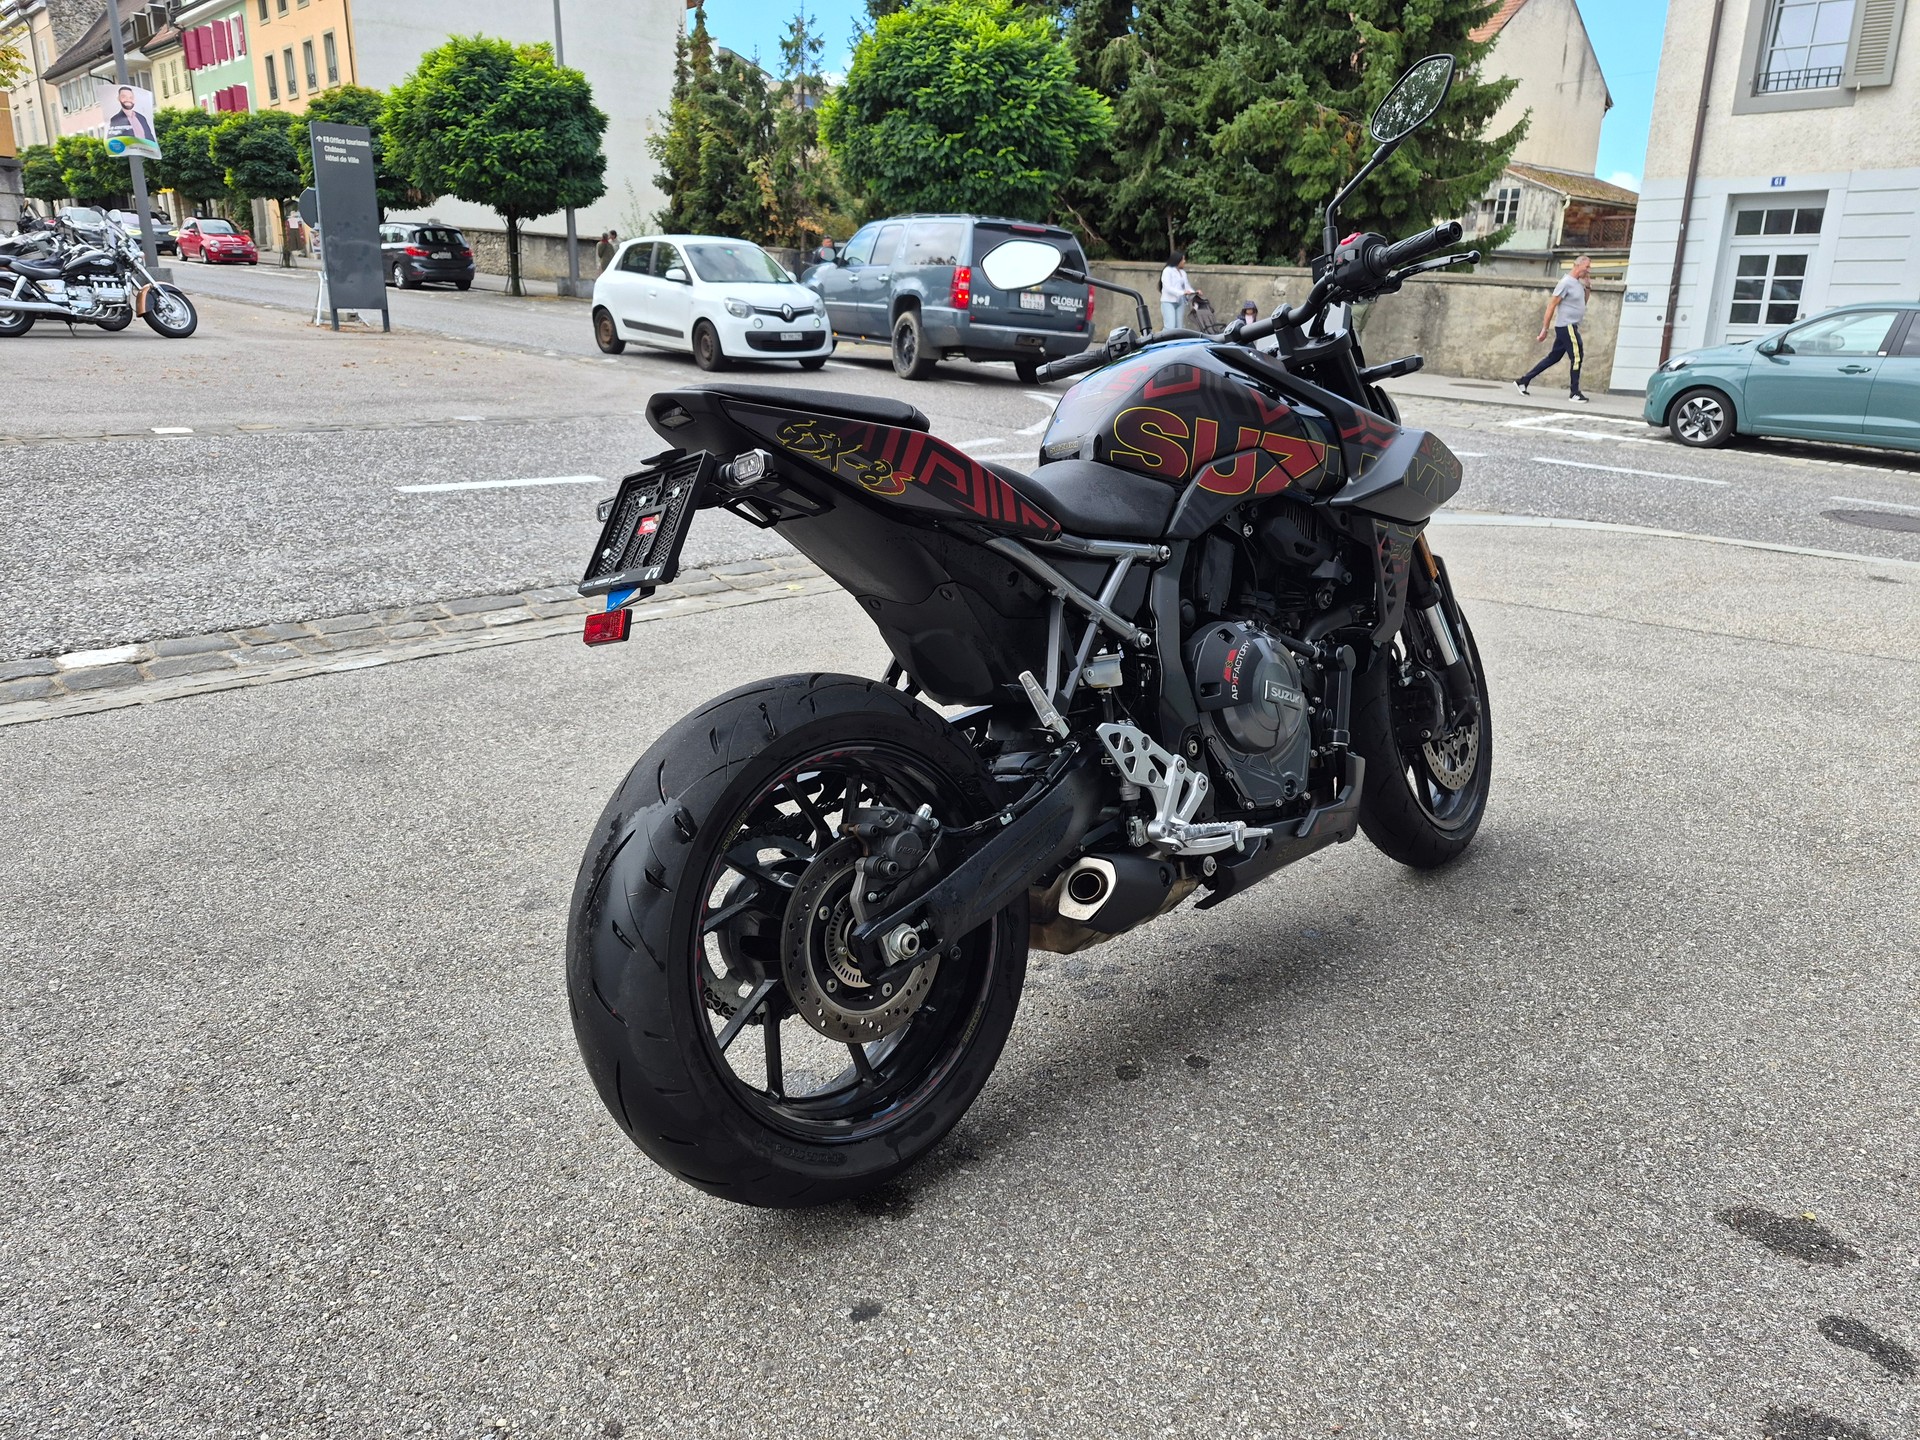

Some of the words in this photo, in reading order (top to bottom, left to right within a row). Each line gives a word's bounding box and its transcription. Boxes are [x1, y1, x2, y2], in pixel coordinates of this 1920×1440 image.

[329, 136, 346, 145] Office
[346, 138, 369, 147] tourisme
[324, 145, 347, 154] Château
[324, 154, 339, 162] Hôtel
[347, 156, 360, 164] Ville
[1774, 177, 1783, 186] 61
[1051, 295, 1084, 308] GLOBULL
[1231, 639, 1251, 700] APXFACTORY
[1270, 686, 1304, 705] SUZUKI
